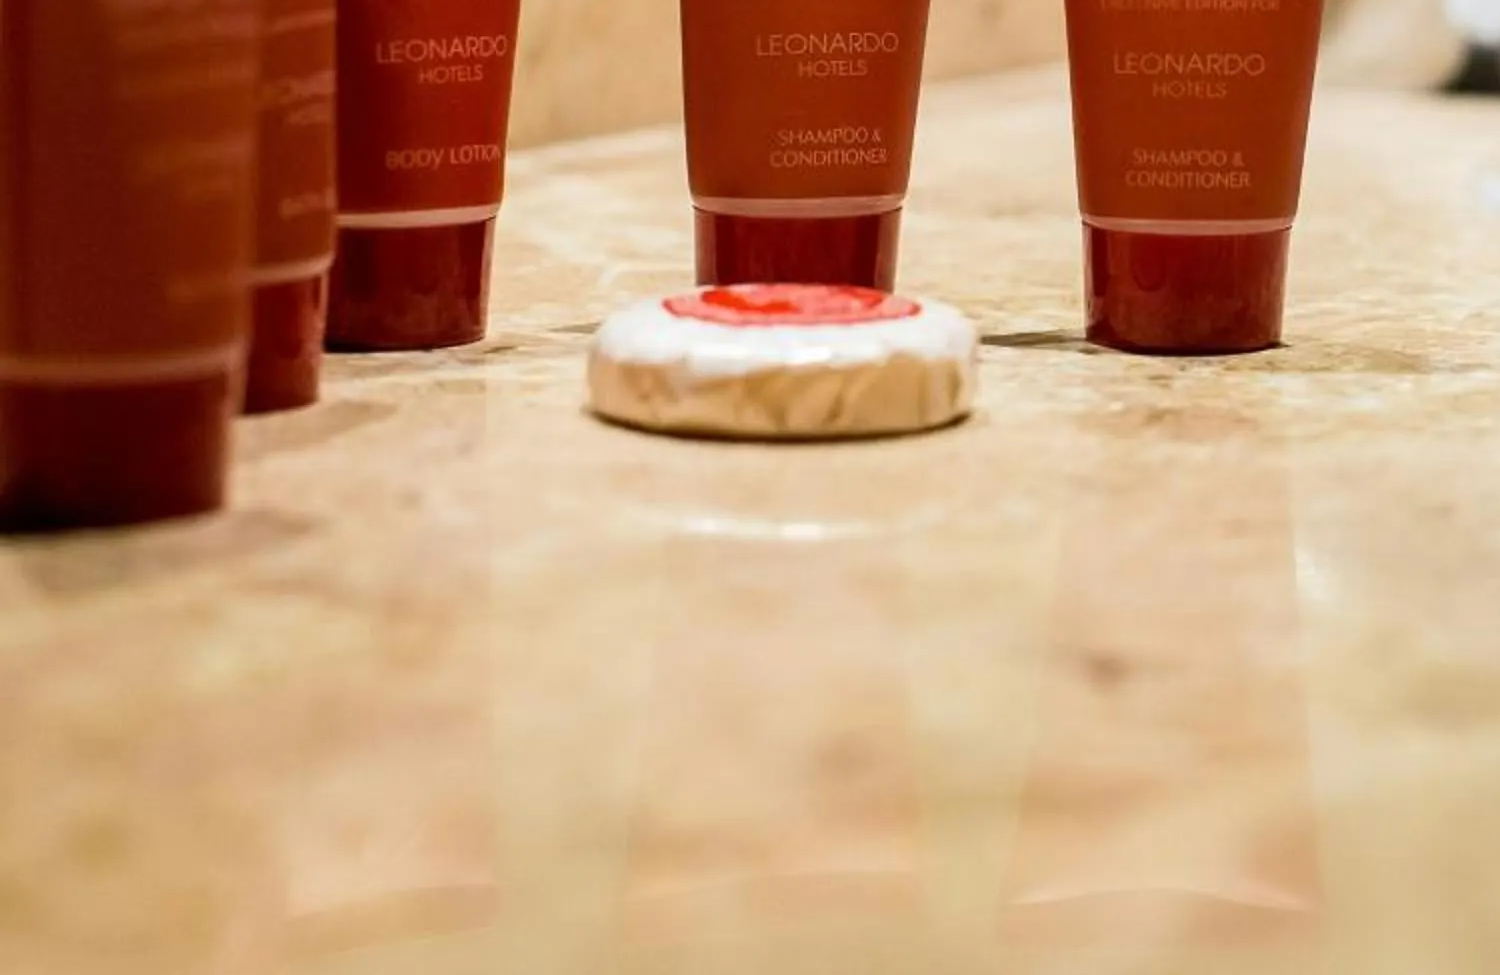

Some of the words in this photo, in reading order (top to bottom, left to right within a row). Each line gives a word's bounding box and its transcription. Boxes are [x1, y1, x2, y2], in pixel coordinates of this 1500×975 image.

[375, 35, 508, 64] LEONARDO
[755, 32, 899, 56] LEONARDO
[418, 64, 485, 85] HOTELS
[799, 59, 868, 77] HOTELS
[1113, 52, 1267, 76] LEONARDO
[1152, 79, 1228, 98] HOTELS
[777, 127, 869, 146] SHAMPOO
[385, 148, 445, 171] BODY
[769, 147, 888, 168] CONDITIONER
[1132, 147, 1228, 167] SHAMPOO
[1231, 151, 1246, 167] &
[1125, 170, 1252, 189] CONDITIONER
